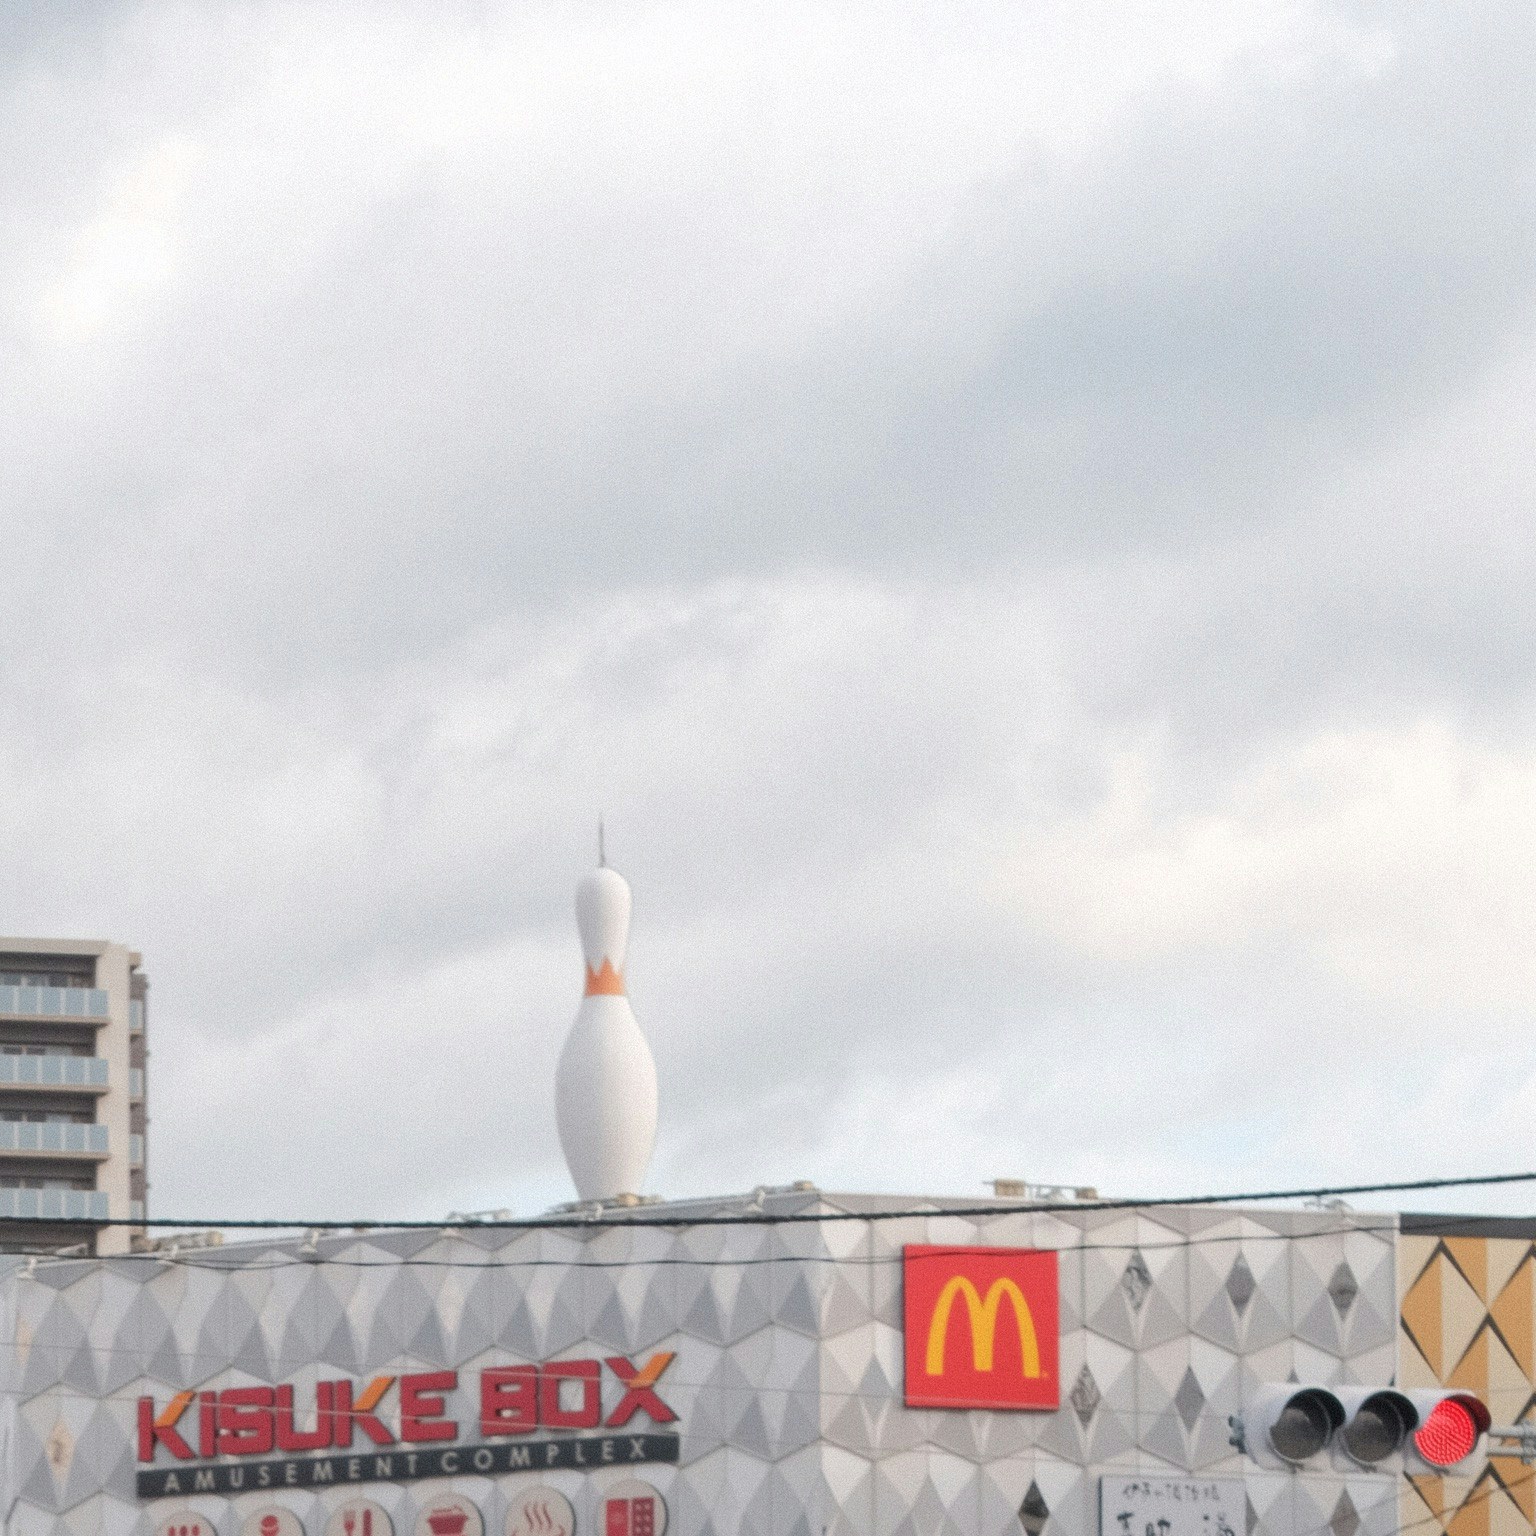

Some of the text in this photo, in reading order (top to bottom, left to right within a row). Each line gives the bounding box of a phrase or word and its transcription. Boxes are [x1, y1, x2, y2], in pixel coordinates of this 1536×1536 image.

[137, 1351, 680, 1463] KISUKE BOX
[163, 1437, 647, 1493] AMUSEMENT COMPLEX
